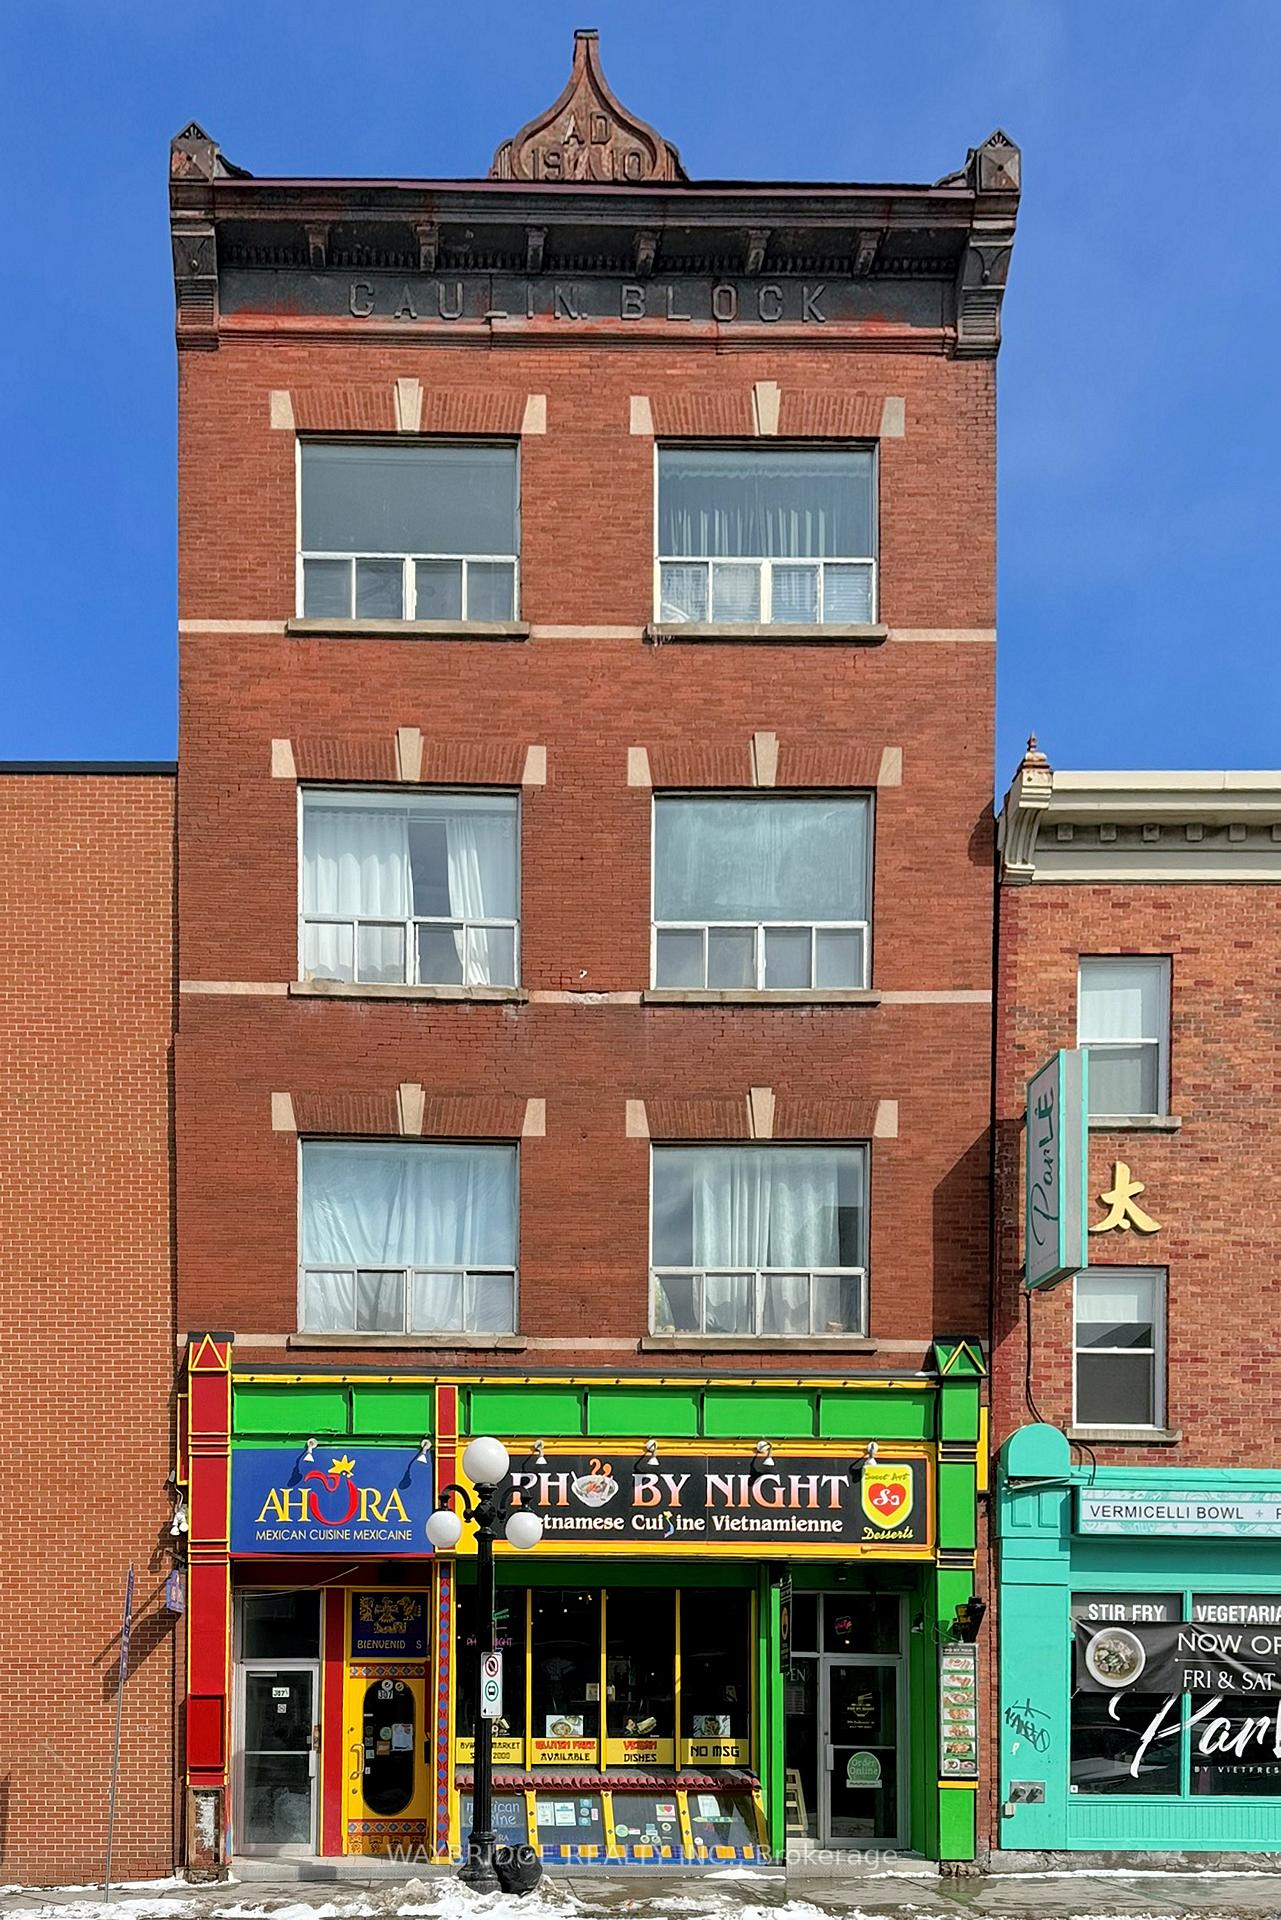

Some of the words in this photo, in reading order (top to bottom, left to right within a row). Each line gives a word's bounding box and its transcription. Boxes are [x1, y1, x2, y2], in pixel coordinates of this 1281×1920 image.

[562, 111, 613, 145] AD
[620, 284, 826, 323] BLOCK
[1088, 1160, 1163, 1233] 太
[254, 1470, 413, 1526] AHORA
[631, 1473, 691, 1507] BY
[704, 1474, 850, 1509] NIGHT
[1090, 1505, 1190, 1519] VERMICELLI
[1196, 1507, 1244, 1520] BOWL
[540, 1513, 625, 1531] tnamese
[711, 1515, 843, 1533] Vietnamienne
[255, 1530, 307, 1540] MEXICAN
[309, 1530, 351, 1540] CUISINE
[353, 1530, 413, 1540] MEXICAINE
[861, 1526, 914, 1540] Desserts
[1088, 1603, 1125, 1621] STIR
[1132, 1604, 1165, 1622] FRY
[1178, 1632, 1243, 1653] NOW
[1183, 1669, 1212, 1689] FRI
[1217, 1670, 1236, 1690] &
[1242, 1671, 1277, 1691] SAT
[492, 1742, 520, 1750] MARKET
[690, 1745, 709, 1757] NO
[712, 1745, 740, 1757] MSG
[540, 1752, 591, 1761] AVAILABLE
[623, 1753, 658, 1762] DISHES
[849, 1766, 878, 1775] Online
